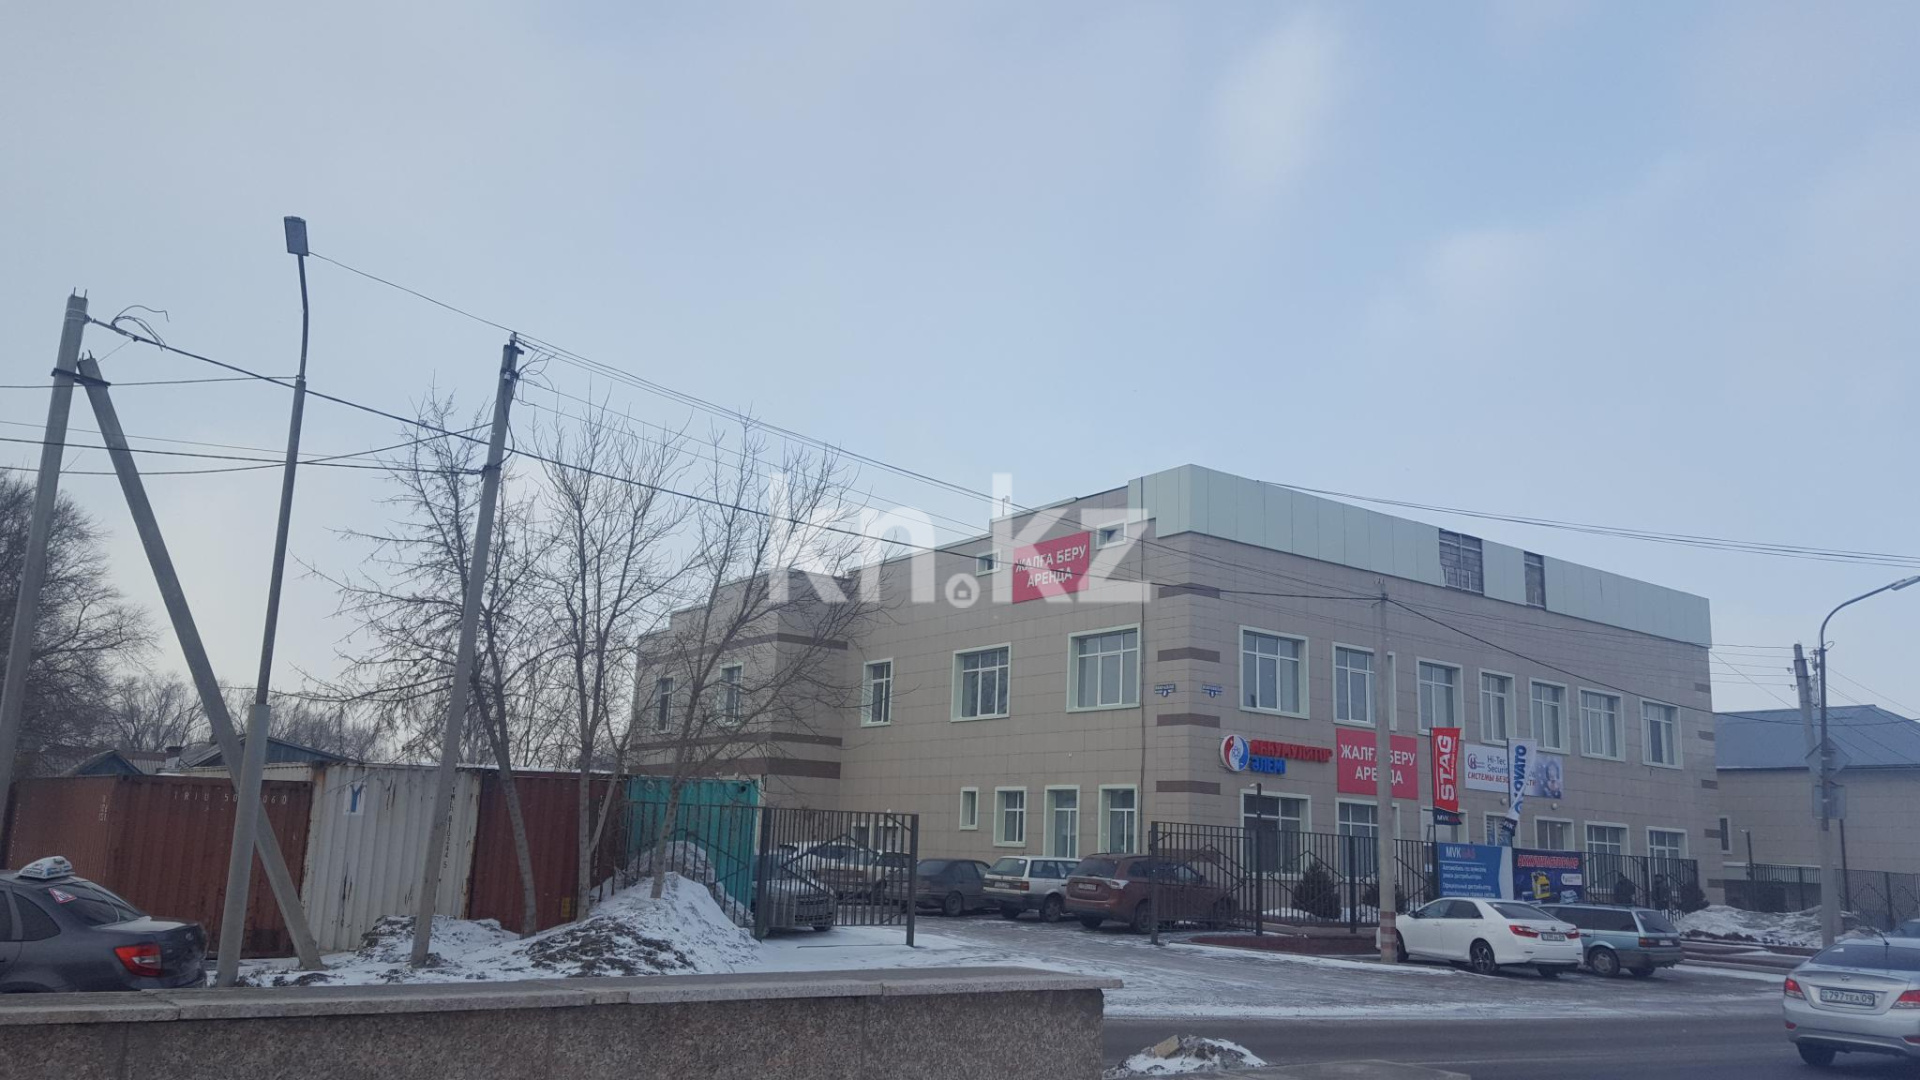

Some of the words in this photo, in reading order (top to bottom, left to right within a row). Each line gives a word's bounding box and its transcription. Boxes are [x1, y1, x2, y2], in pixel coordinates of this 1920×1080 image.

[1056, 544, 1087, 564] БЕРУ
[1026, 566, 1073, 588] АРЕНДА
[1340, 744, 1378, 762] ЖАЛҒ
[1437, 735, 1455, 801] STAG
[1467, 771, 1494, 782] СИСТЕМЫ
[1513, 744, 1527, 798] OVATO
